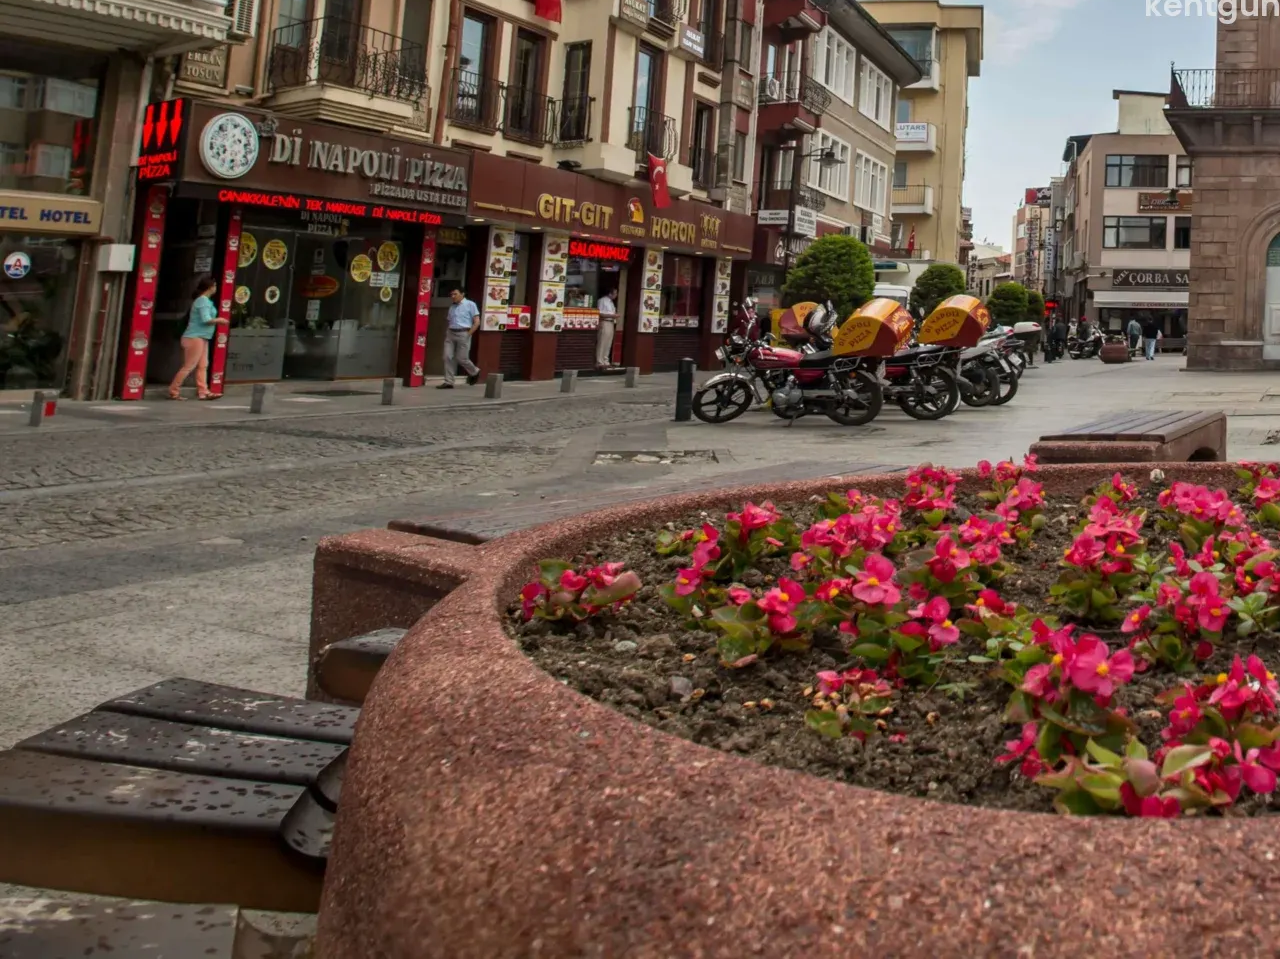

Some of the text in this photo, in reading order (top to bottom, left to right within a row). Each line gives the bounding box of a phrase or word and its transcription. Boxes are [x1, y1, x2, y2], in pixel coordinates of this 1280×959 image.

[187, 65, 220, 80] TOSUN
[268, 128, 468, 192] Dİ NAPOLİ PİZZA
[417, 190, 440, 203] USTA
[441, 194, 467, 206] ELLER
[306, 199, 322, 211] TEK
[325, 202, 367, 216] MARKASI
[40, 209, 92, 224] HOTEL
[570, 240, 630, 261] SALONUMUZ
[1113, 270, 1129, 285] ÖZEL
[1129, 273, 1170, 285] ÇORBA
